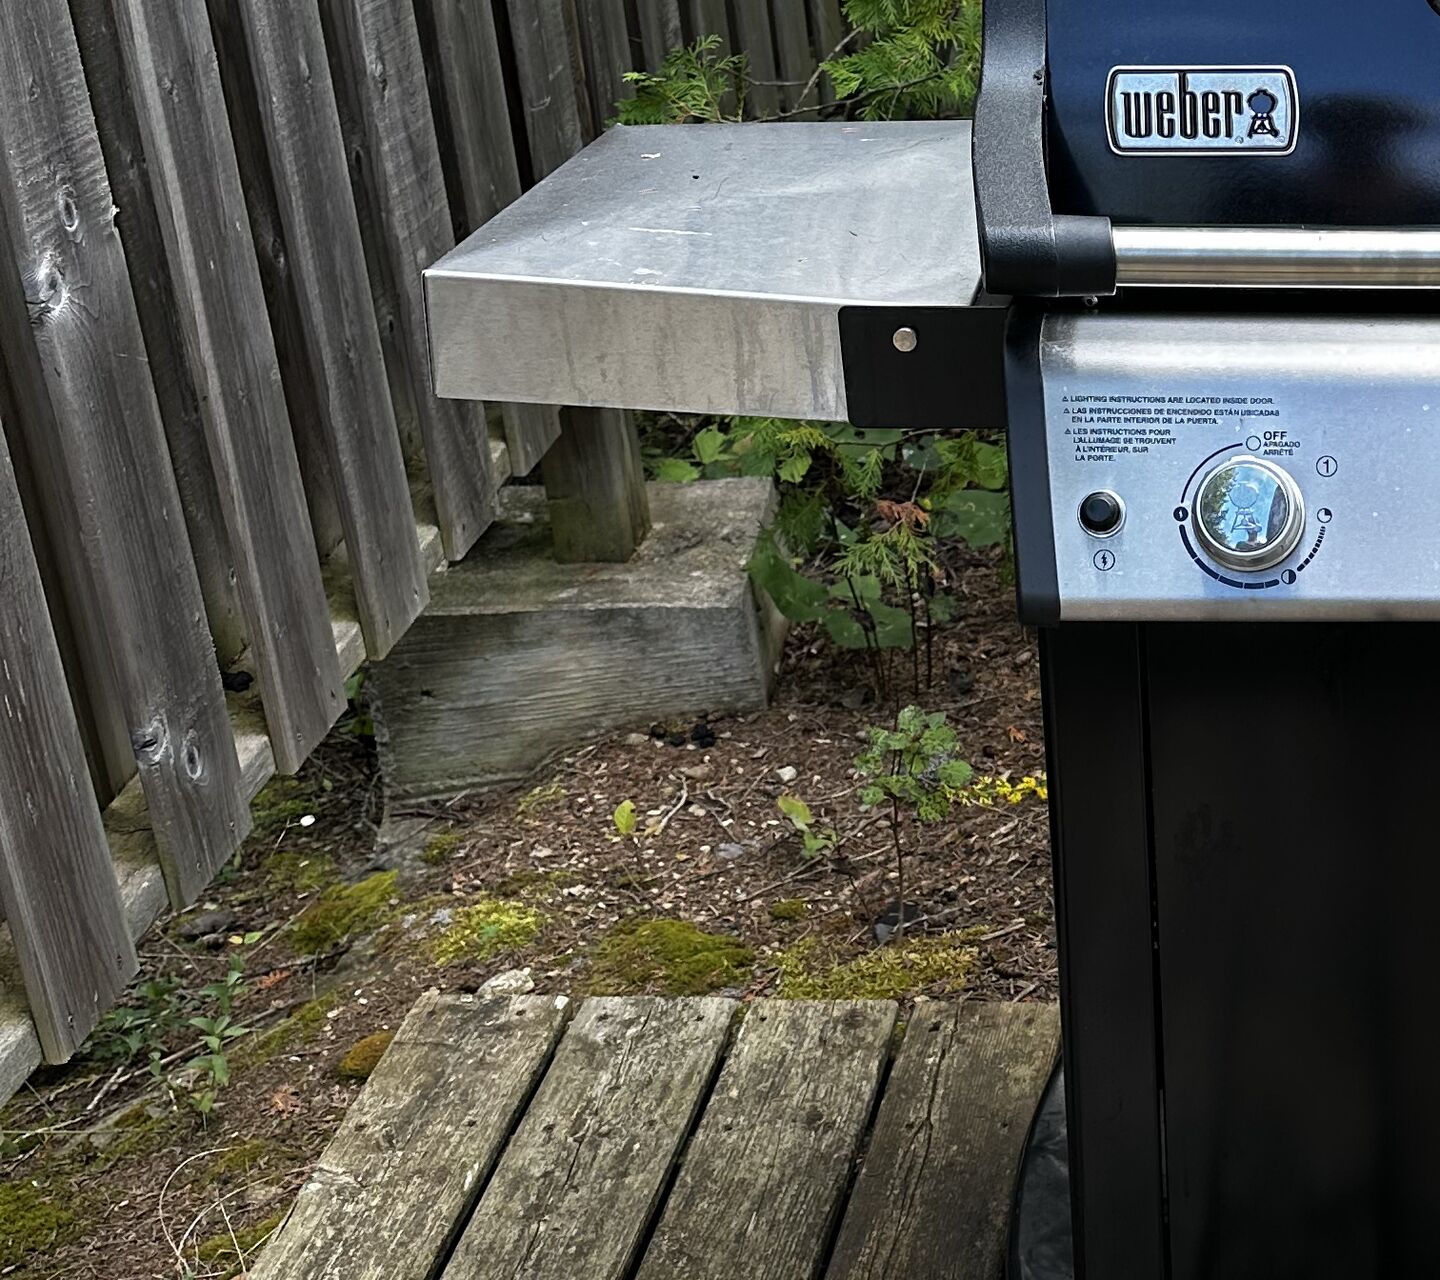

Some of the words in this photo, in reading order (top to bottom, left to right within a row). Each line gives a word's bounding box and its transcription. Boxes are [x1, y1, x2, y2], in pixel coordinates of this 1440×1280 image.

[1120, 71, 1244, 140] weber
[1109, 396, 1166, 404] INSTRUCTIONS
[1168, 396, 1184, 404] ARE
[1222, 397, 1248, 405] INSIDE
[1089, 407, 1152, 415] INSTRUCCIONES
[1166, 408, 1212, 416] ENCENDIDO
[1241, 409, 1280, 417] UBICADAS
[1134, 437, 1176, 445] TROUVENT
[1263, 431, 1288, 441] OFF
